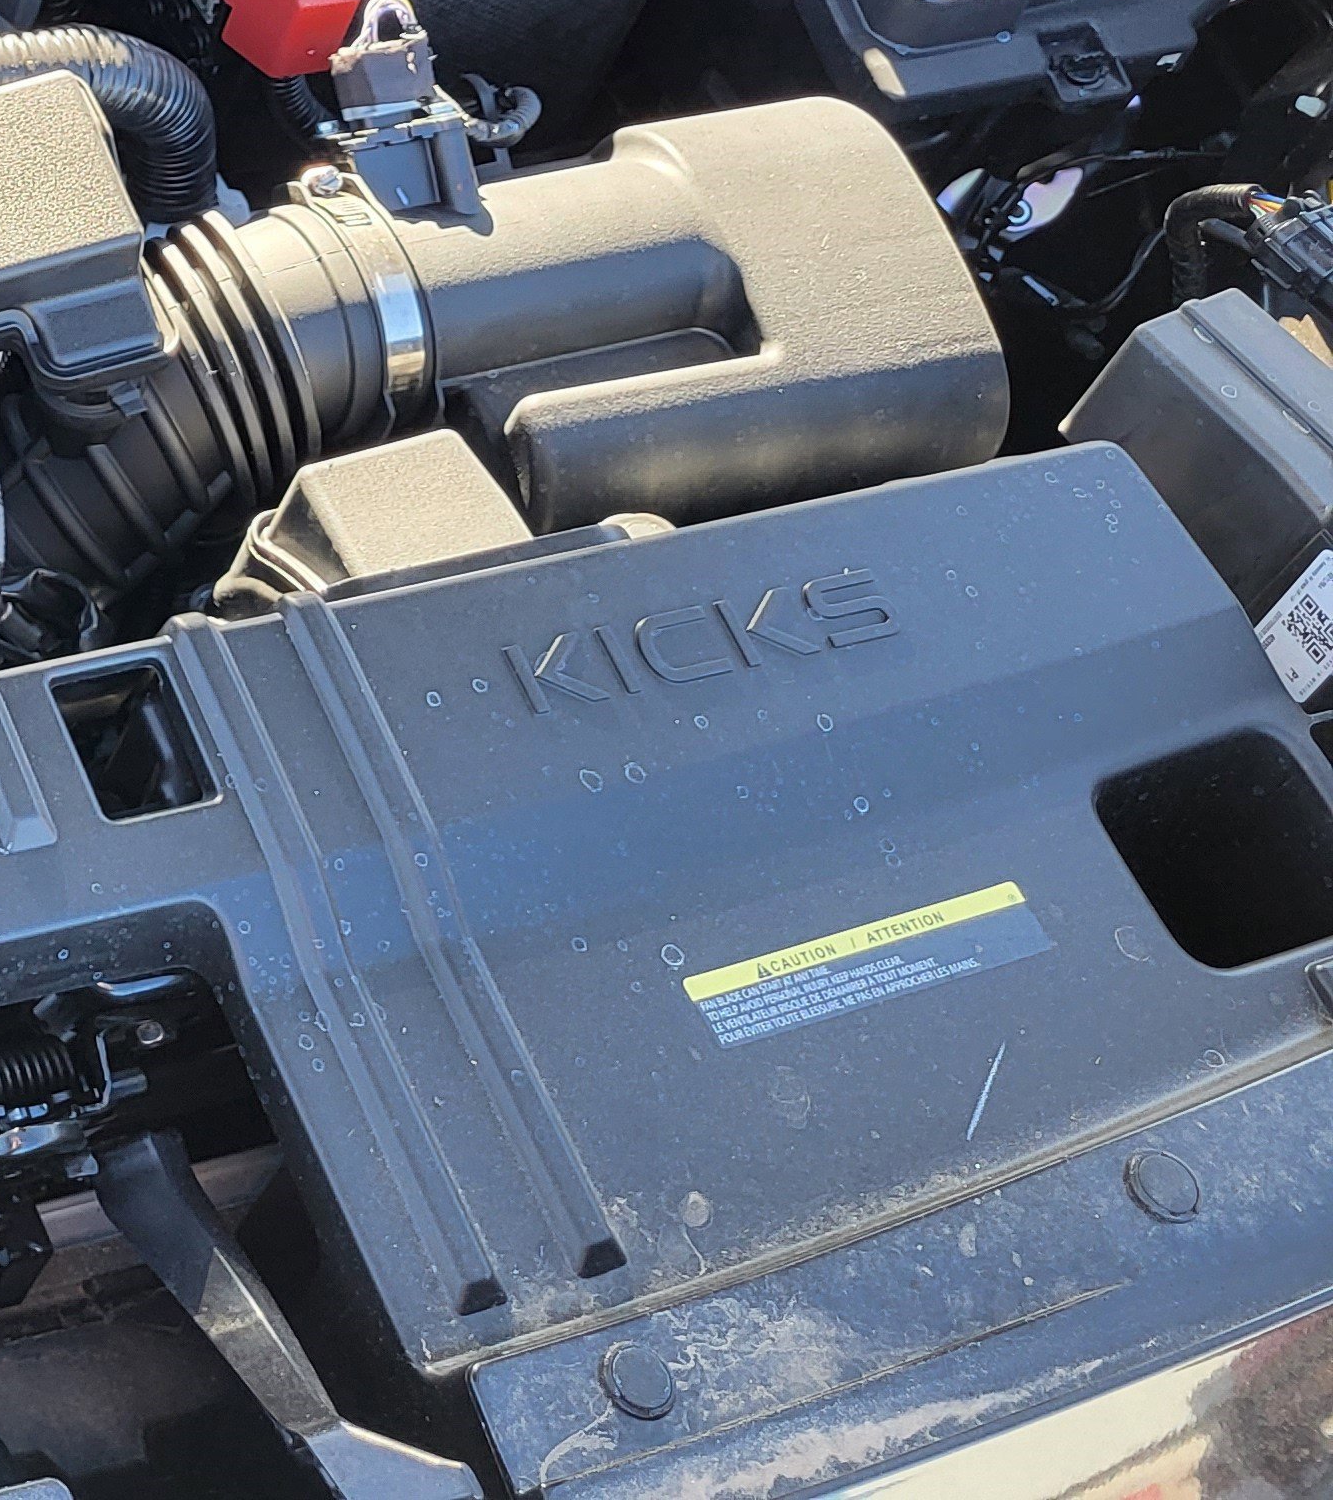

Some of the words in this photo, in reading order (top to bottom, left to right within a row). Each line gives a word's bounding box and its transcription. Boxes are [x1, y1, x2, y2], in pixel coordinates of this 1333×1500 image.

[502, 568, 900, 716] KICKS
[769, 942, 838, 974] CAUTION
[865, 909, 946, 945] ATTENTION
[705, 1009, 720, 1023] TO
[718, 1003, 740, 1019] HELP
[830, 970, 850, 985] KEEP
[848, 961, 878, 980] HANDS
[710, 1020, 725, 1035] LE
[809, 991, 824, 1006] DE
[874, 968, 898, 985] TOUT
[717, 1027, 745, 1045] POUR
[771, 1010, 802, 1029] TOUTE
[841, 992, 857, 1007] NE
[854, 988, 873, 1003] PAS
[870, 984, 886, 998] EN
[883, 969, 936, 994] APPROCHER
[933, 965, 951, 980] LES
[740, 984, 761, 1000] CAN
